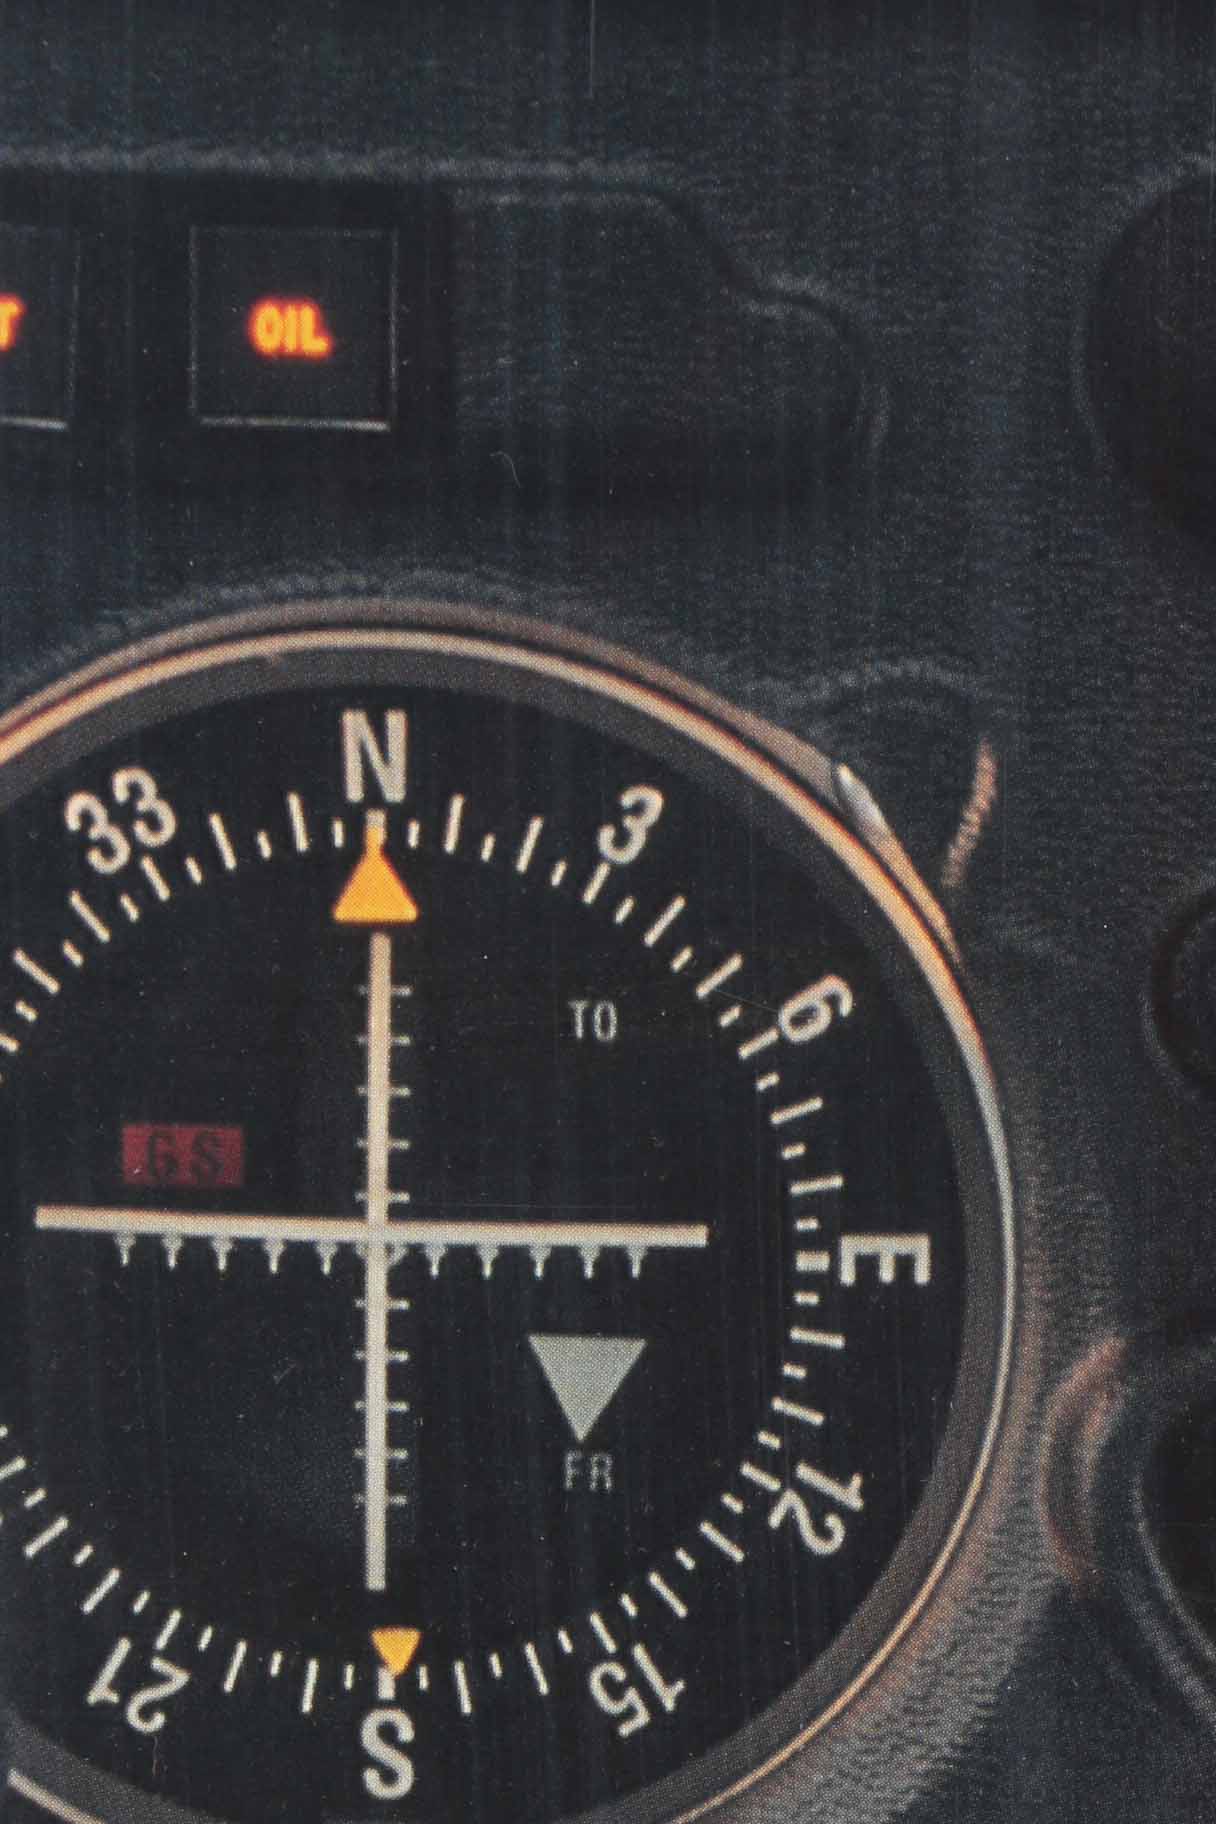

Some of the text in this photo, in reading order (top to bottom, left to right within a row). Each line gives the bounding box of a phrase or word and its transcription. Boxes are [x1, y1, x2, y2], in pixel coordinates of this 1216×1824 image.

[249, 300, 332, 357] OIL
[341, 709, 408, 803] N
[64, 767, 177, 874] 33
[599, 785, 665, 864] 3
[570, 1000, 618, 1042] TO
[778, 974, 854, 1043] 6
[147, 1129, 222, 1182] GS
[839, 1234, 931, 1286] E
[564, 1450, 613, 1492] FR
[768, 1462, 864, 1555] 12
[86, 1638, 190, 1734] 21
[589, 1641, 685, 1737] 15
[360, 1708, 415, 1799] S
